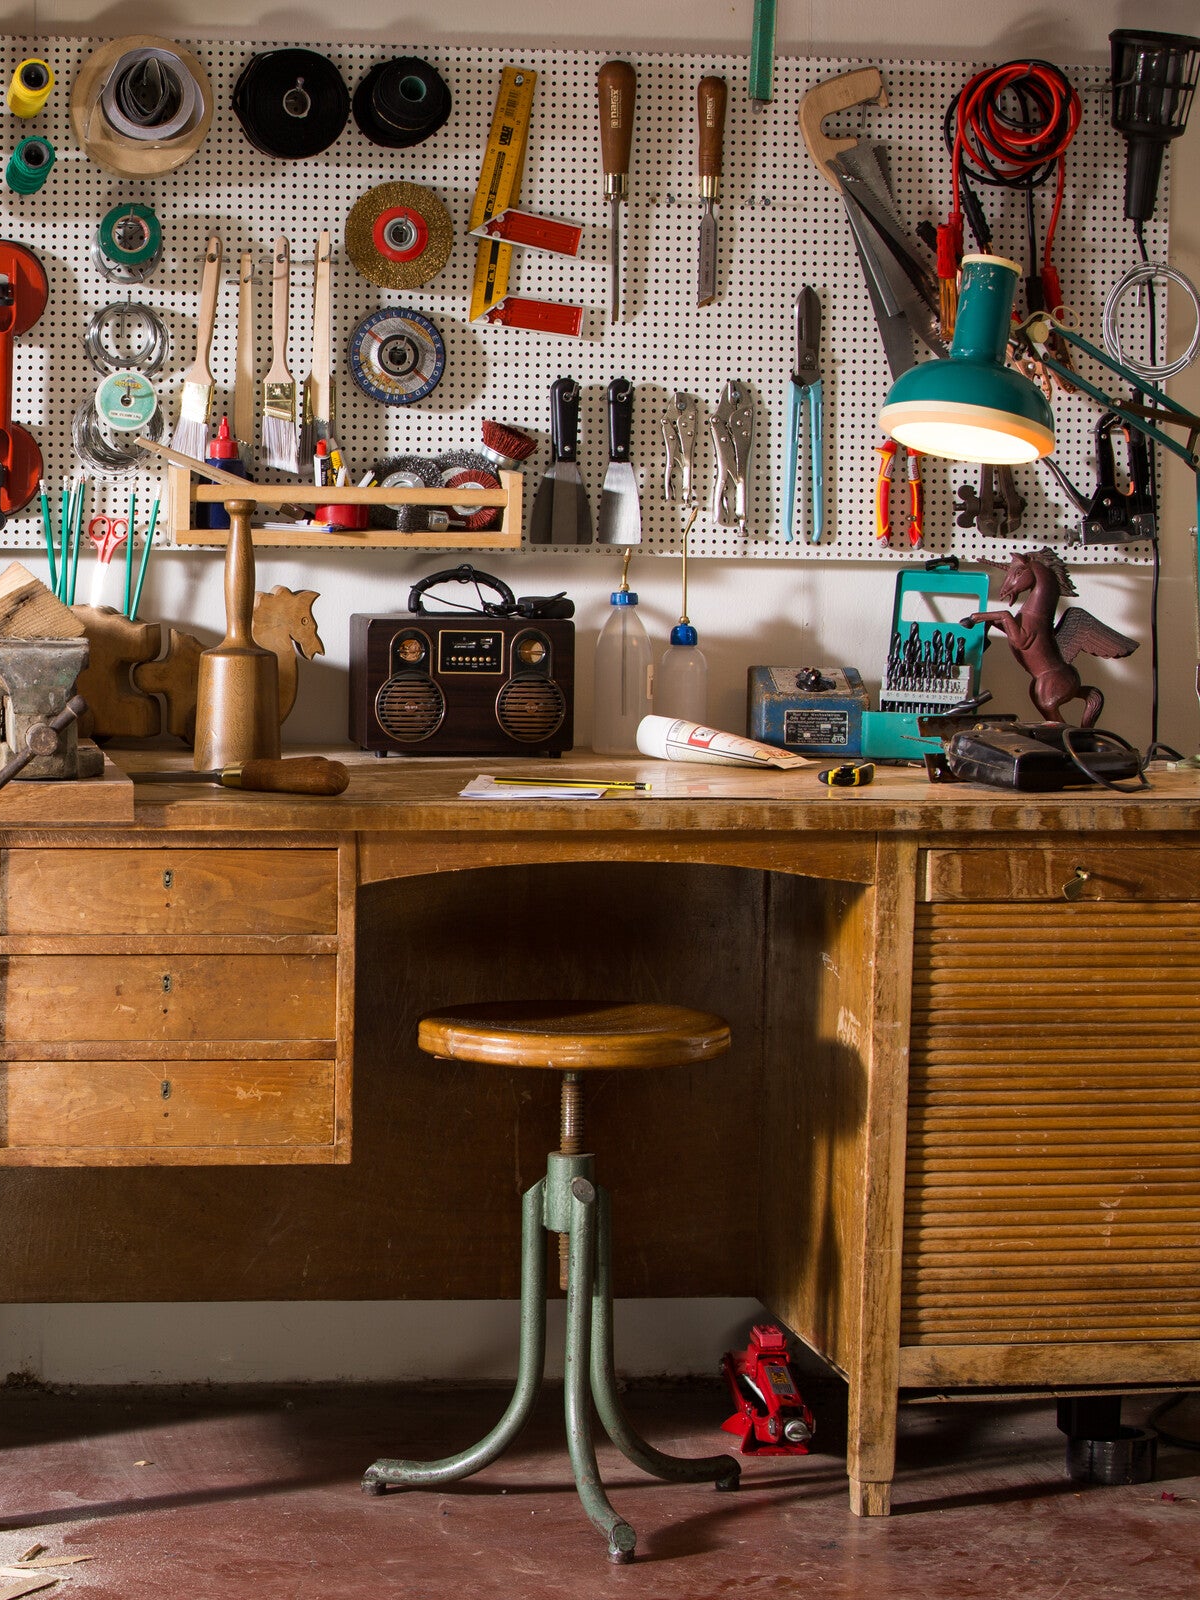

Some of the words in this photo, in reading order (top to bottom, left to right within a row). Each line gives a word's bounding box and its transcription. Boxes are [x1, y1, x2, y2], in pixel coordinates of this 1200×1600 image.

[610, 89, 619, 118] narex
[355, 314, 385, 346] CAMEL
[392, 311, 441, 348] LINEFLEX
[353, 355, 377, 393] WORD
